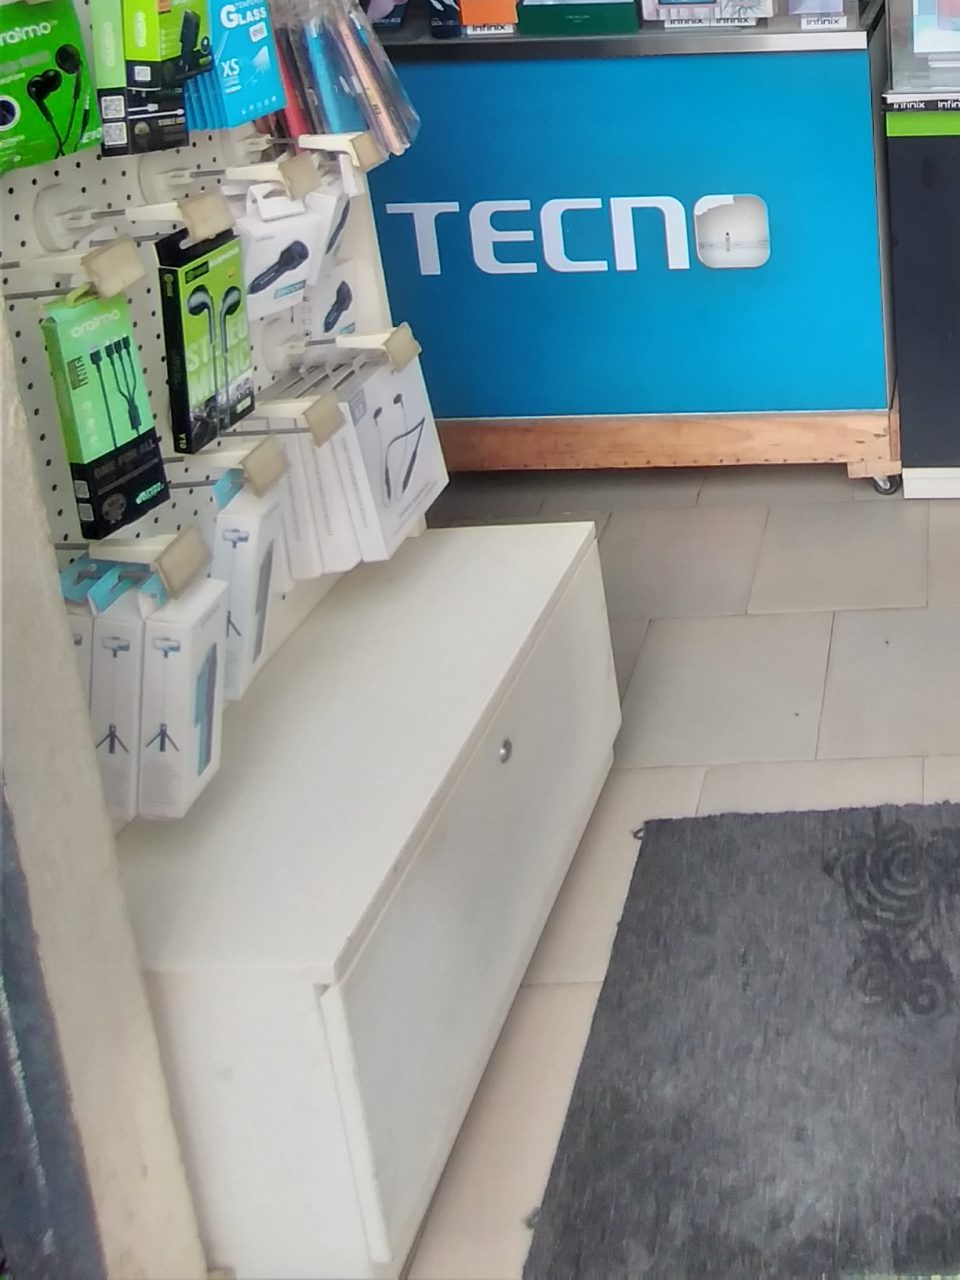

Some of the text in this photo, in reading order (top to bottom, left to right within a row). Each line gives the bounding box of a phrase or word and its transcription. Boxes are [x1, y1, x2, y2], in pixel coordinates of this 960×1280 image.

[220, 4, 268, 29] GLASS
[806, 17, 841, 26] Infinix
[472, 23, 506, 33] Infinix
[221, 58, 240, 78] XS
[71, 308, 121, 340] oraimo
